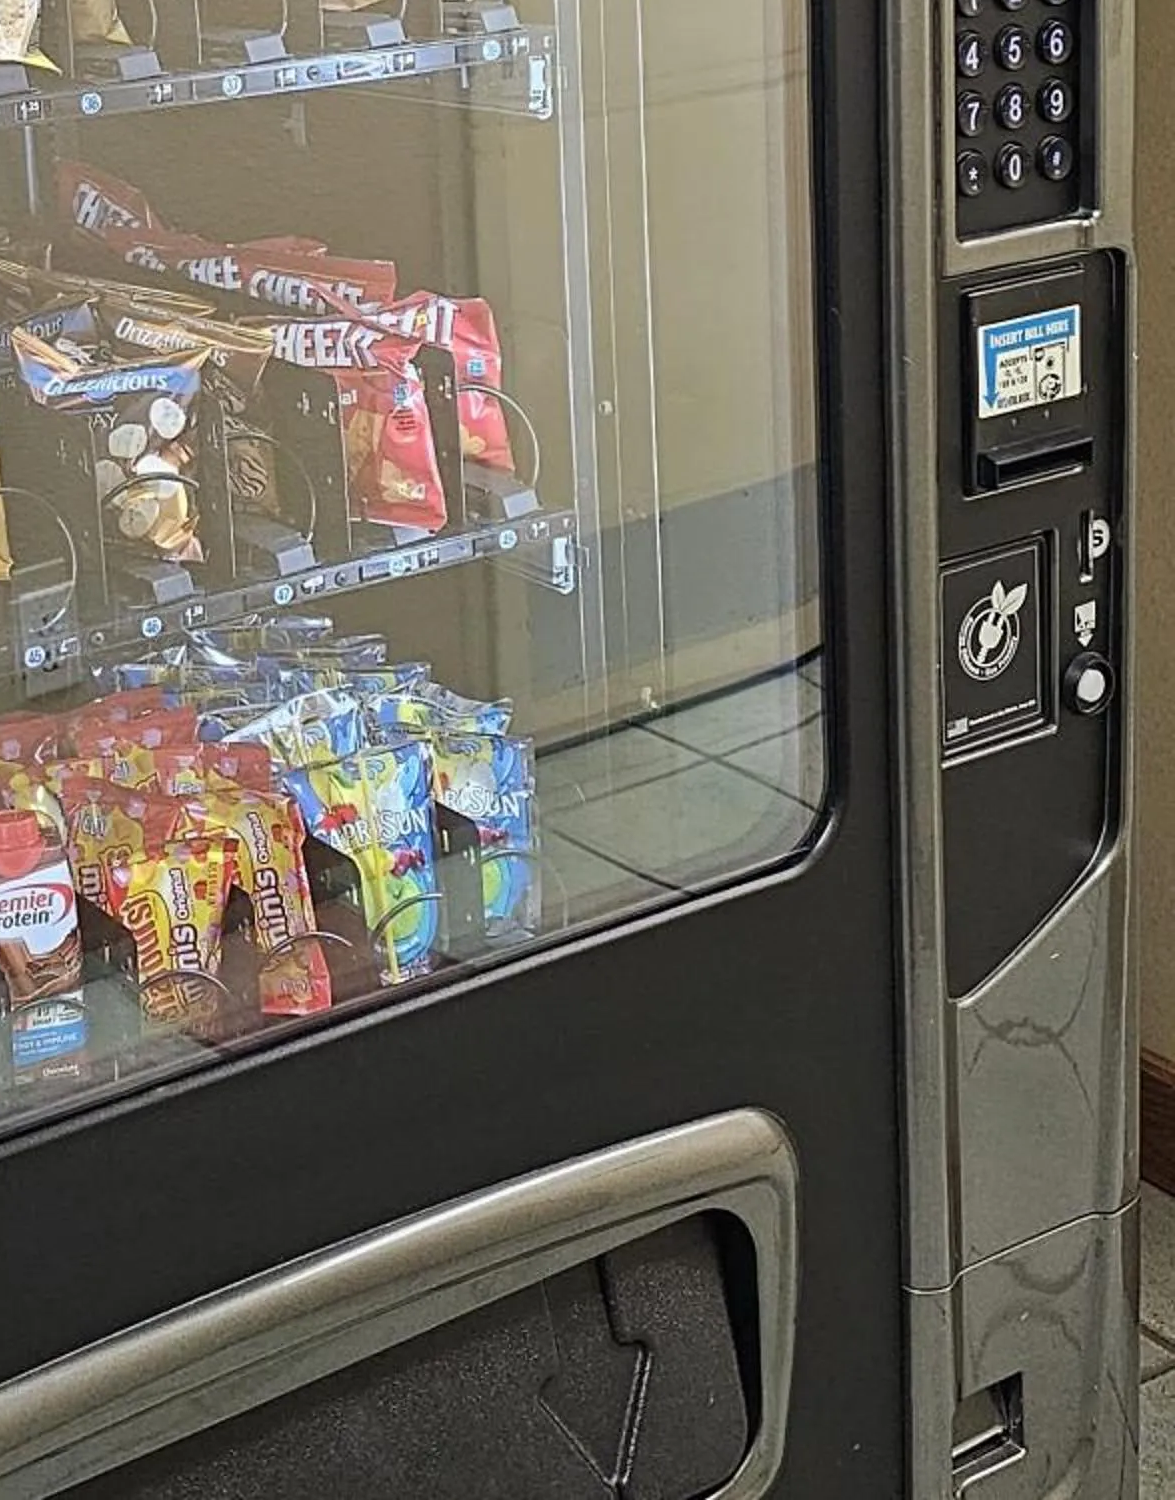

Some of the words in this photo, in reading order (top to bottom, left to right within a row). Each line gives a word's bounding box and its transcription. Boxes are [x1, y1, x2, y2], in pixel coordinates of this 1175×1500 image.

[965, 41, 978, 69] 4
[1008, 35, 1022, 63] 5
[1050, 28, 1064, 57] 6
[968, 102, 979, 130] 7
[1009, 94, 1022, 121] 8
[1050, 89, 1064, 115] 9
[1009, 154, 1022, 181] 0
[990, 329, 1023, 349] INSERT
[1025, 324, 1044, 341] BILL
[1046, 319, 1069, 335] HERE
[379, 808, 426, 844] SUN
[467, 783, 520, 818] SUN
[247, 812, 269, 864] Original
[169, 868, 190, 920] Original
